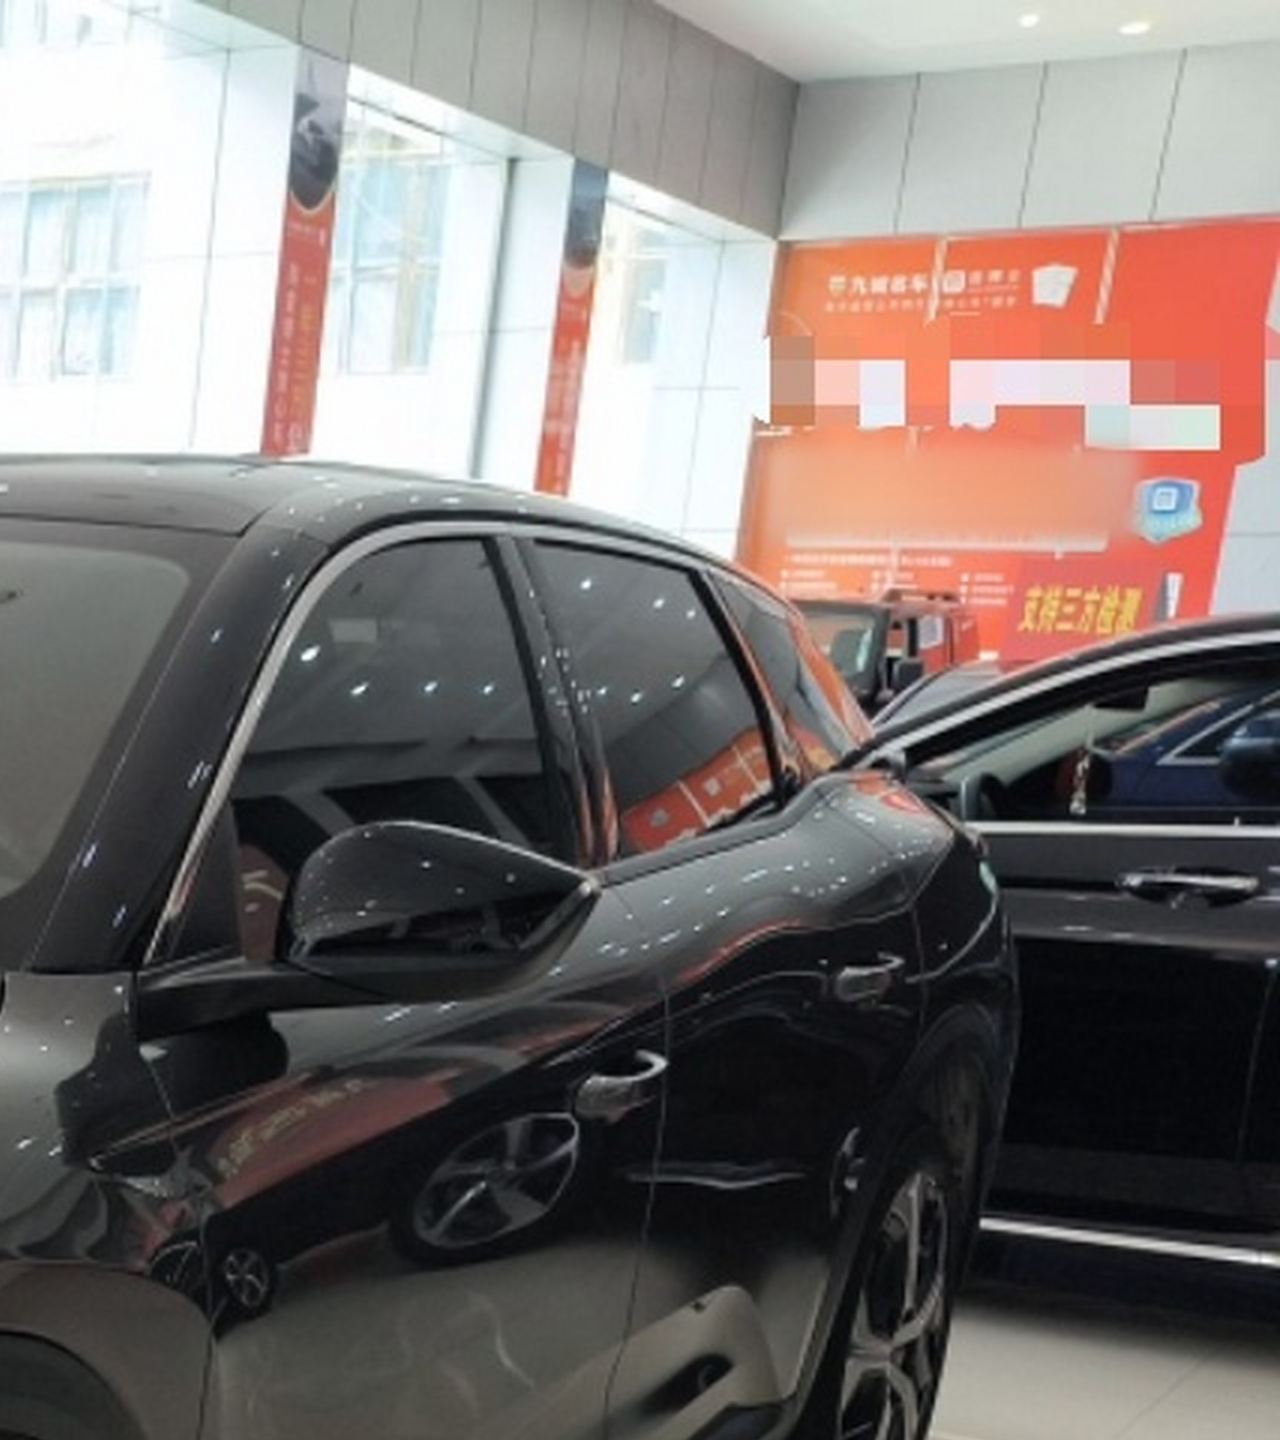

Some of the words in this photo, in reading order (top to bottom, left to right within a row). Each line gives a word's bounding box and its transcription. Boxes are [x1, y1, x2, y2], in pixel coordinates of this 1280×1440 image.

[1017, 584, 1142, 635] 支持三方检测
